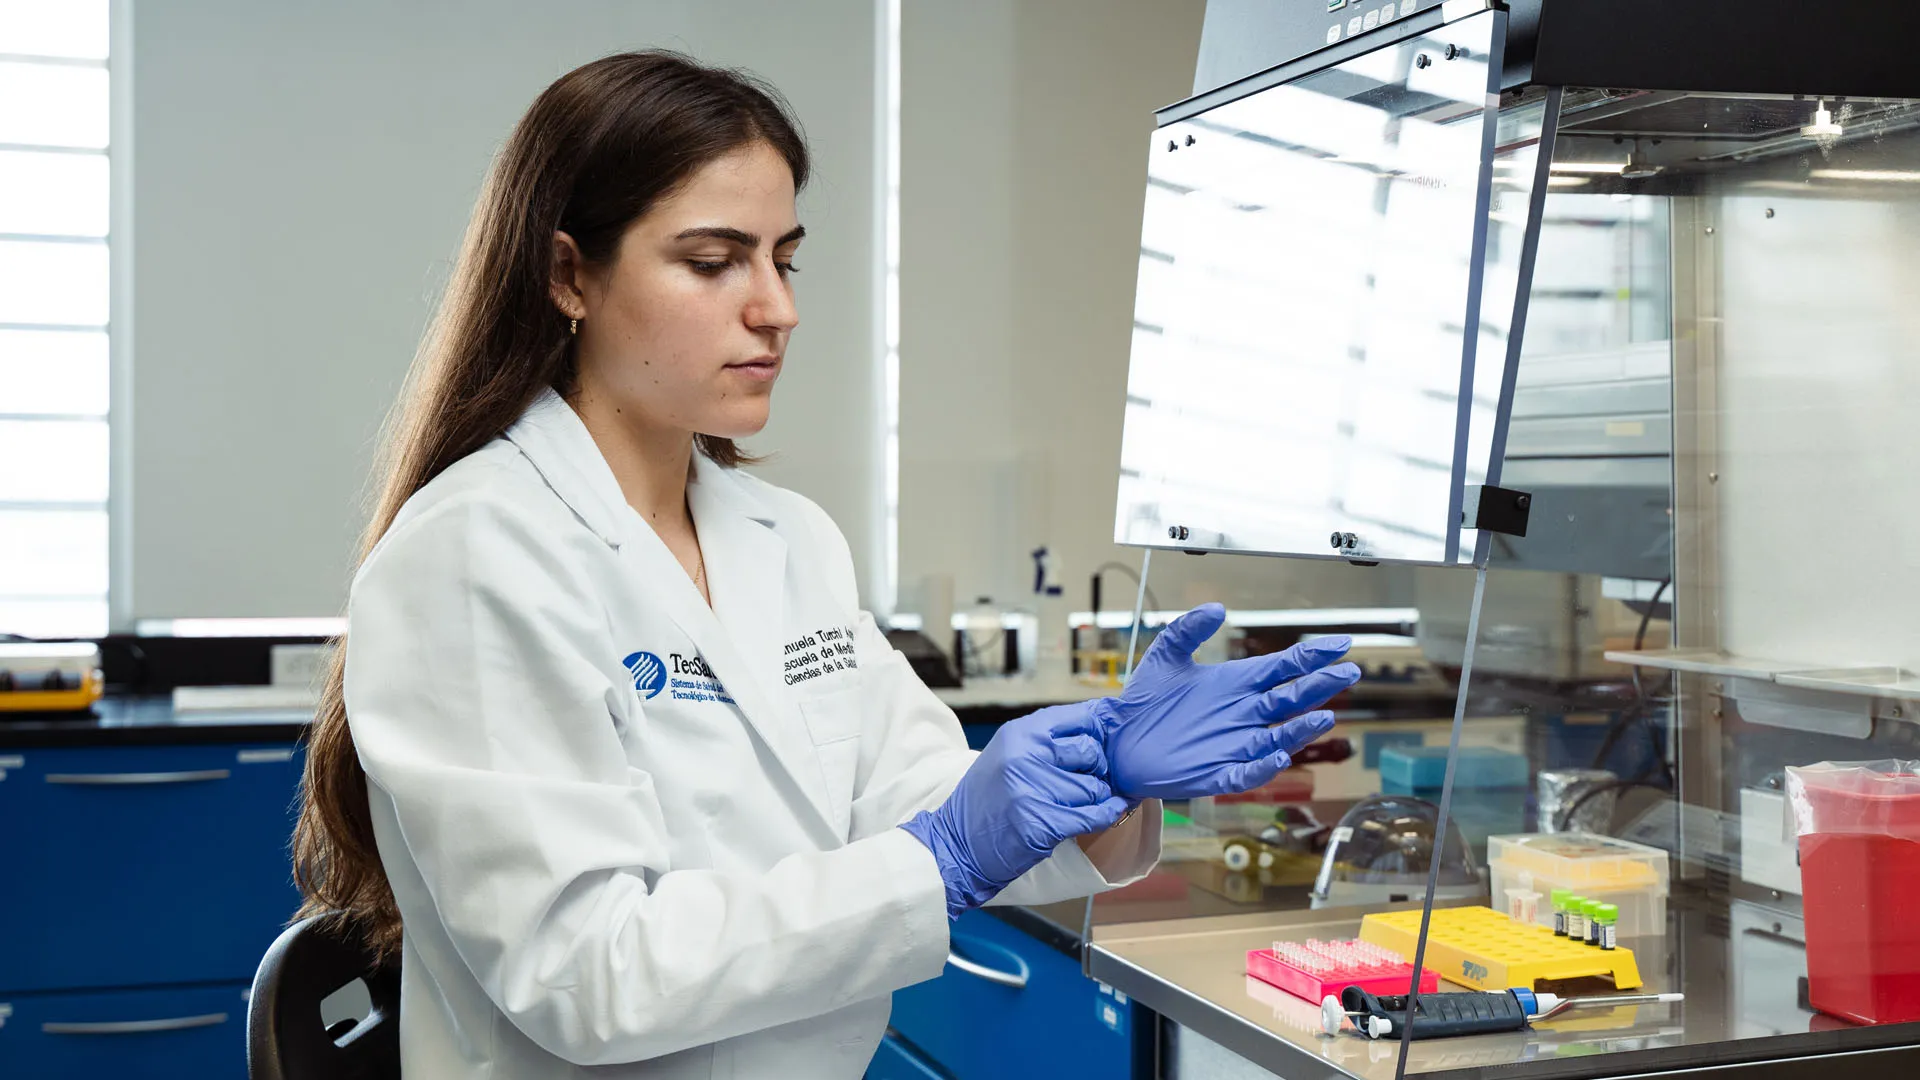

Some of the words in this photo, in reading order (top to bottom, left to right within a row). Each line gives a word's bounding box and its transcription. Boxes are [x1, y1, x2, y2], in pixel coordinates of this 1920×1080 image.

[784, 635, 816, 655] nuela
[820, 646, 834, 659] de
[784, 667, 822, 686] Ciencias
[822, 661, 835, 674] de
[833, 658, 845, 671] la
[670, 678, 695, 689] Sistema
[696, 680, 702, 690] de
[708, 692, 716, 702] de
